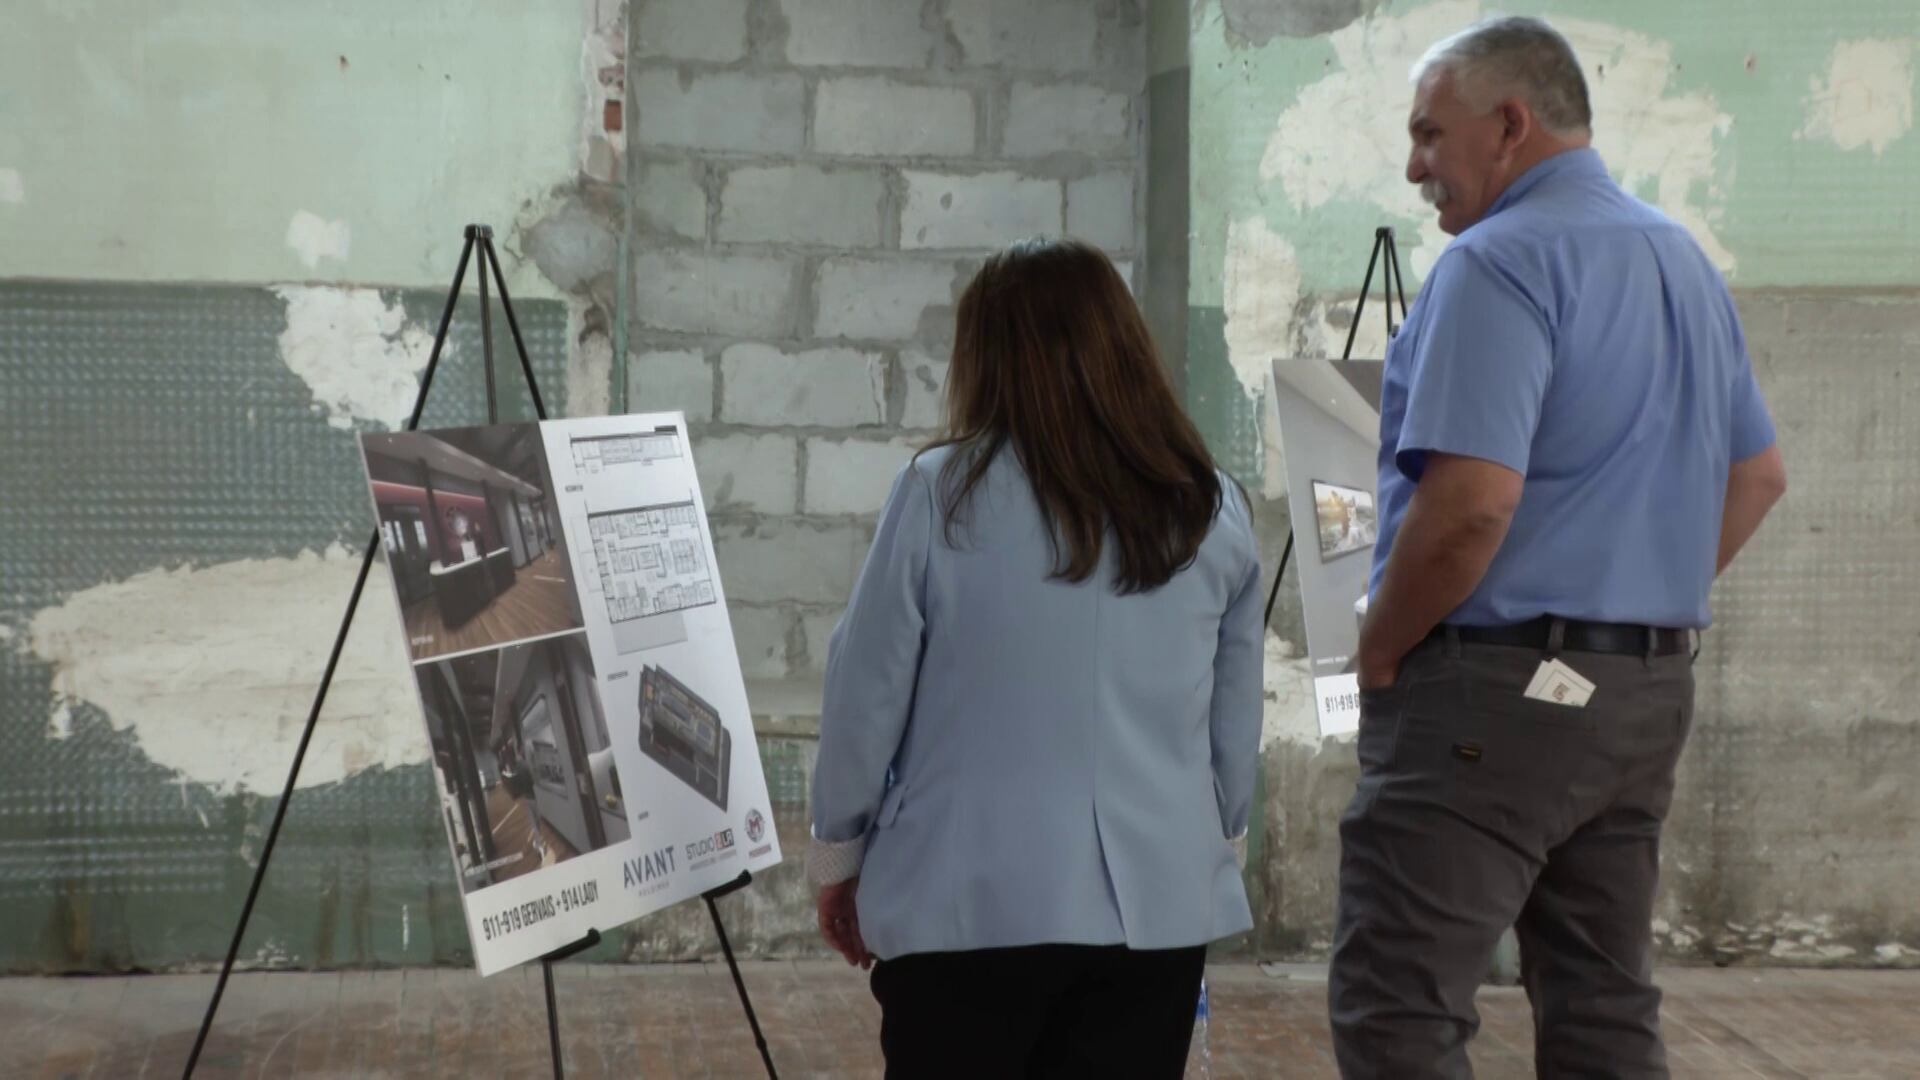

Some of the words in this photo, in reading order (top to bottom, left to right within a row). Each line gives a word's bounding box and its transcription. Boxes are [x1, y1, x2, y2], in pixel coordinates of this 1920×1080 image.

[623, 845, 675, 889] AVANT
[482, 906, 522, 941] 911-919
[520, 894, 556, 927] GERVAIS
[561, 888, 580, 912] 914
[578, 879, 599, 907] LADY
